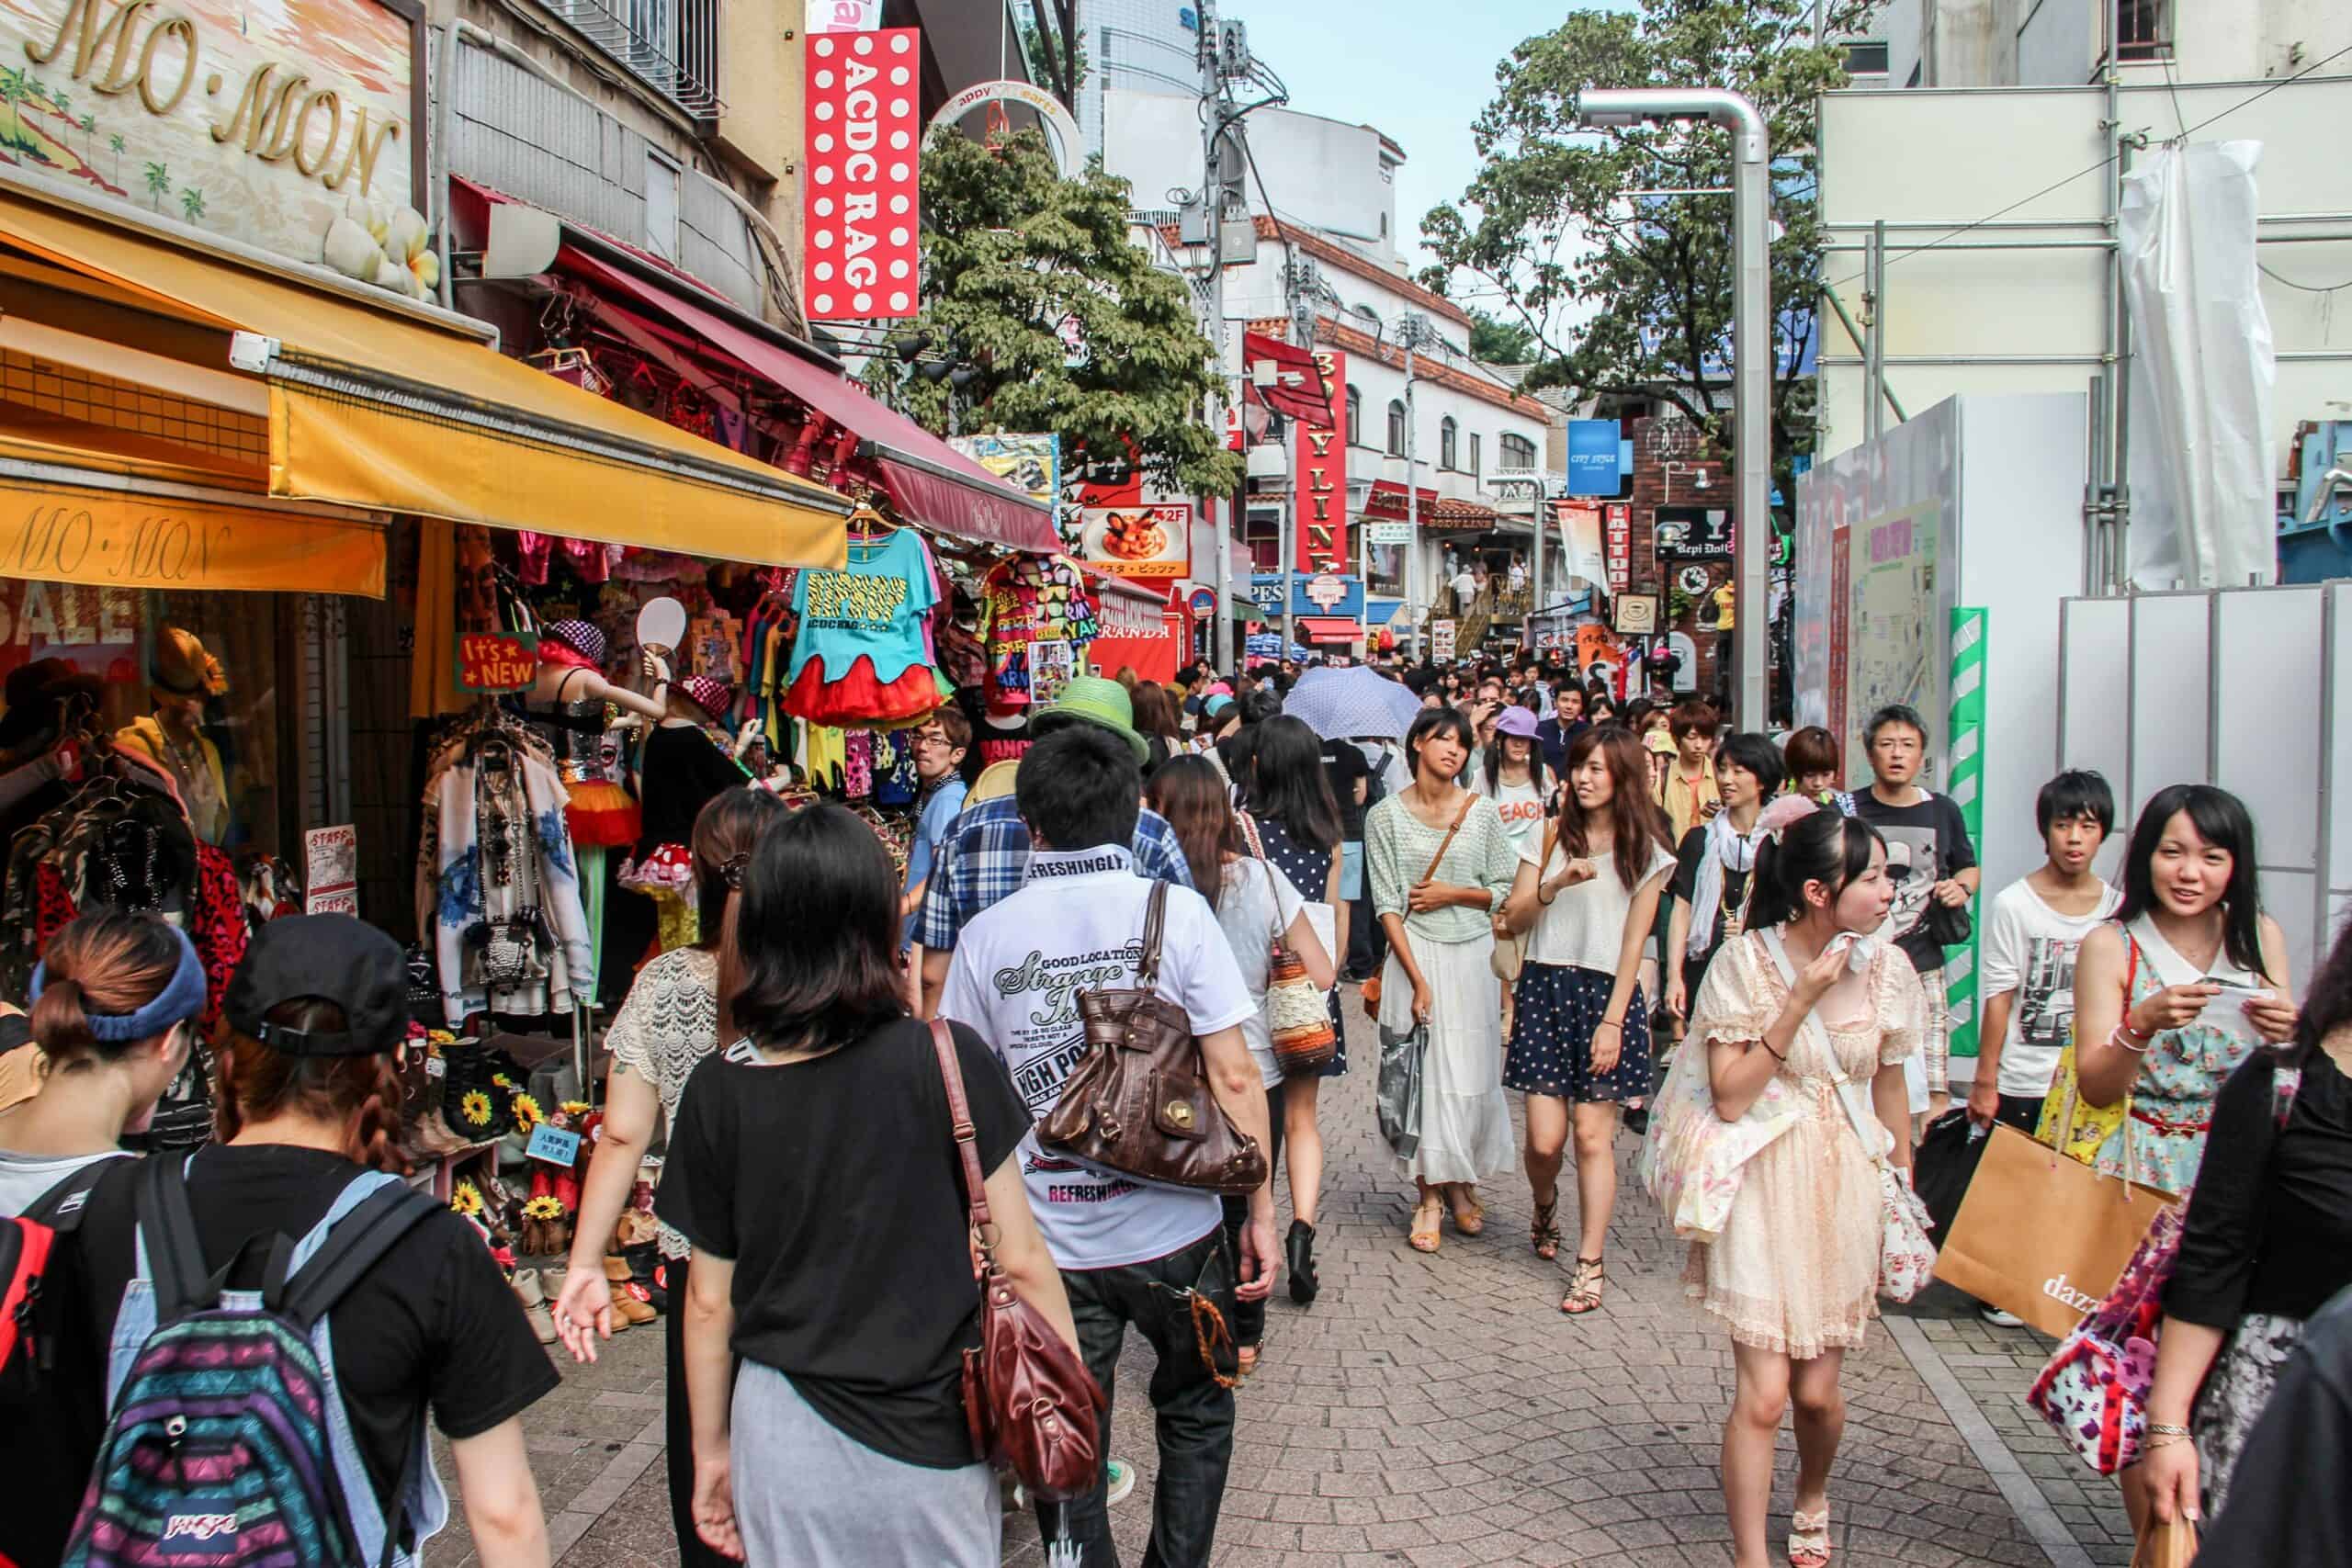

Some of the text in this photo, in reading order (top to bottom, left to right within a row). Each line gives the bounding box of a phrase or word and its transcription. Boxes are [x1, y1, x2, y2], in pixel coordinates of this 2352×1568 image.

[844, 57, 877, 288] ACDC RAG
[1166, 509, 1184, 522] 2F
[464, 638, 501, 661] It's
[481, 662, 534, 687] NEW
[312, 830, 347, 846] STAFF
[993, 950, 1123, 999] Strange
[1042, 956, 1080, 970] GOOD
